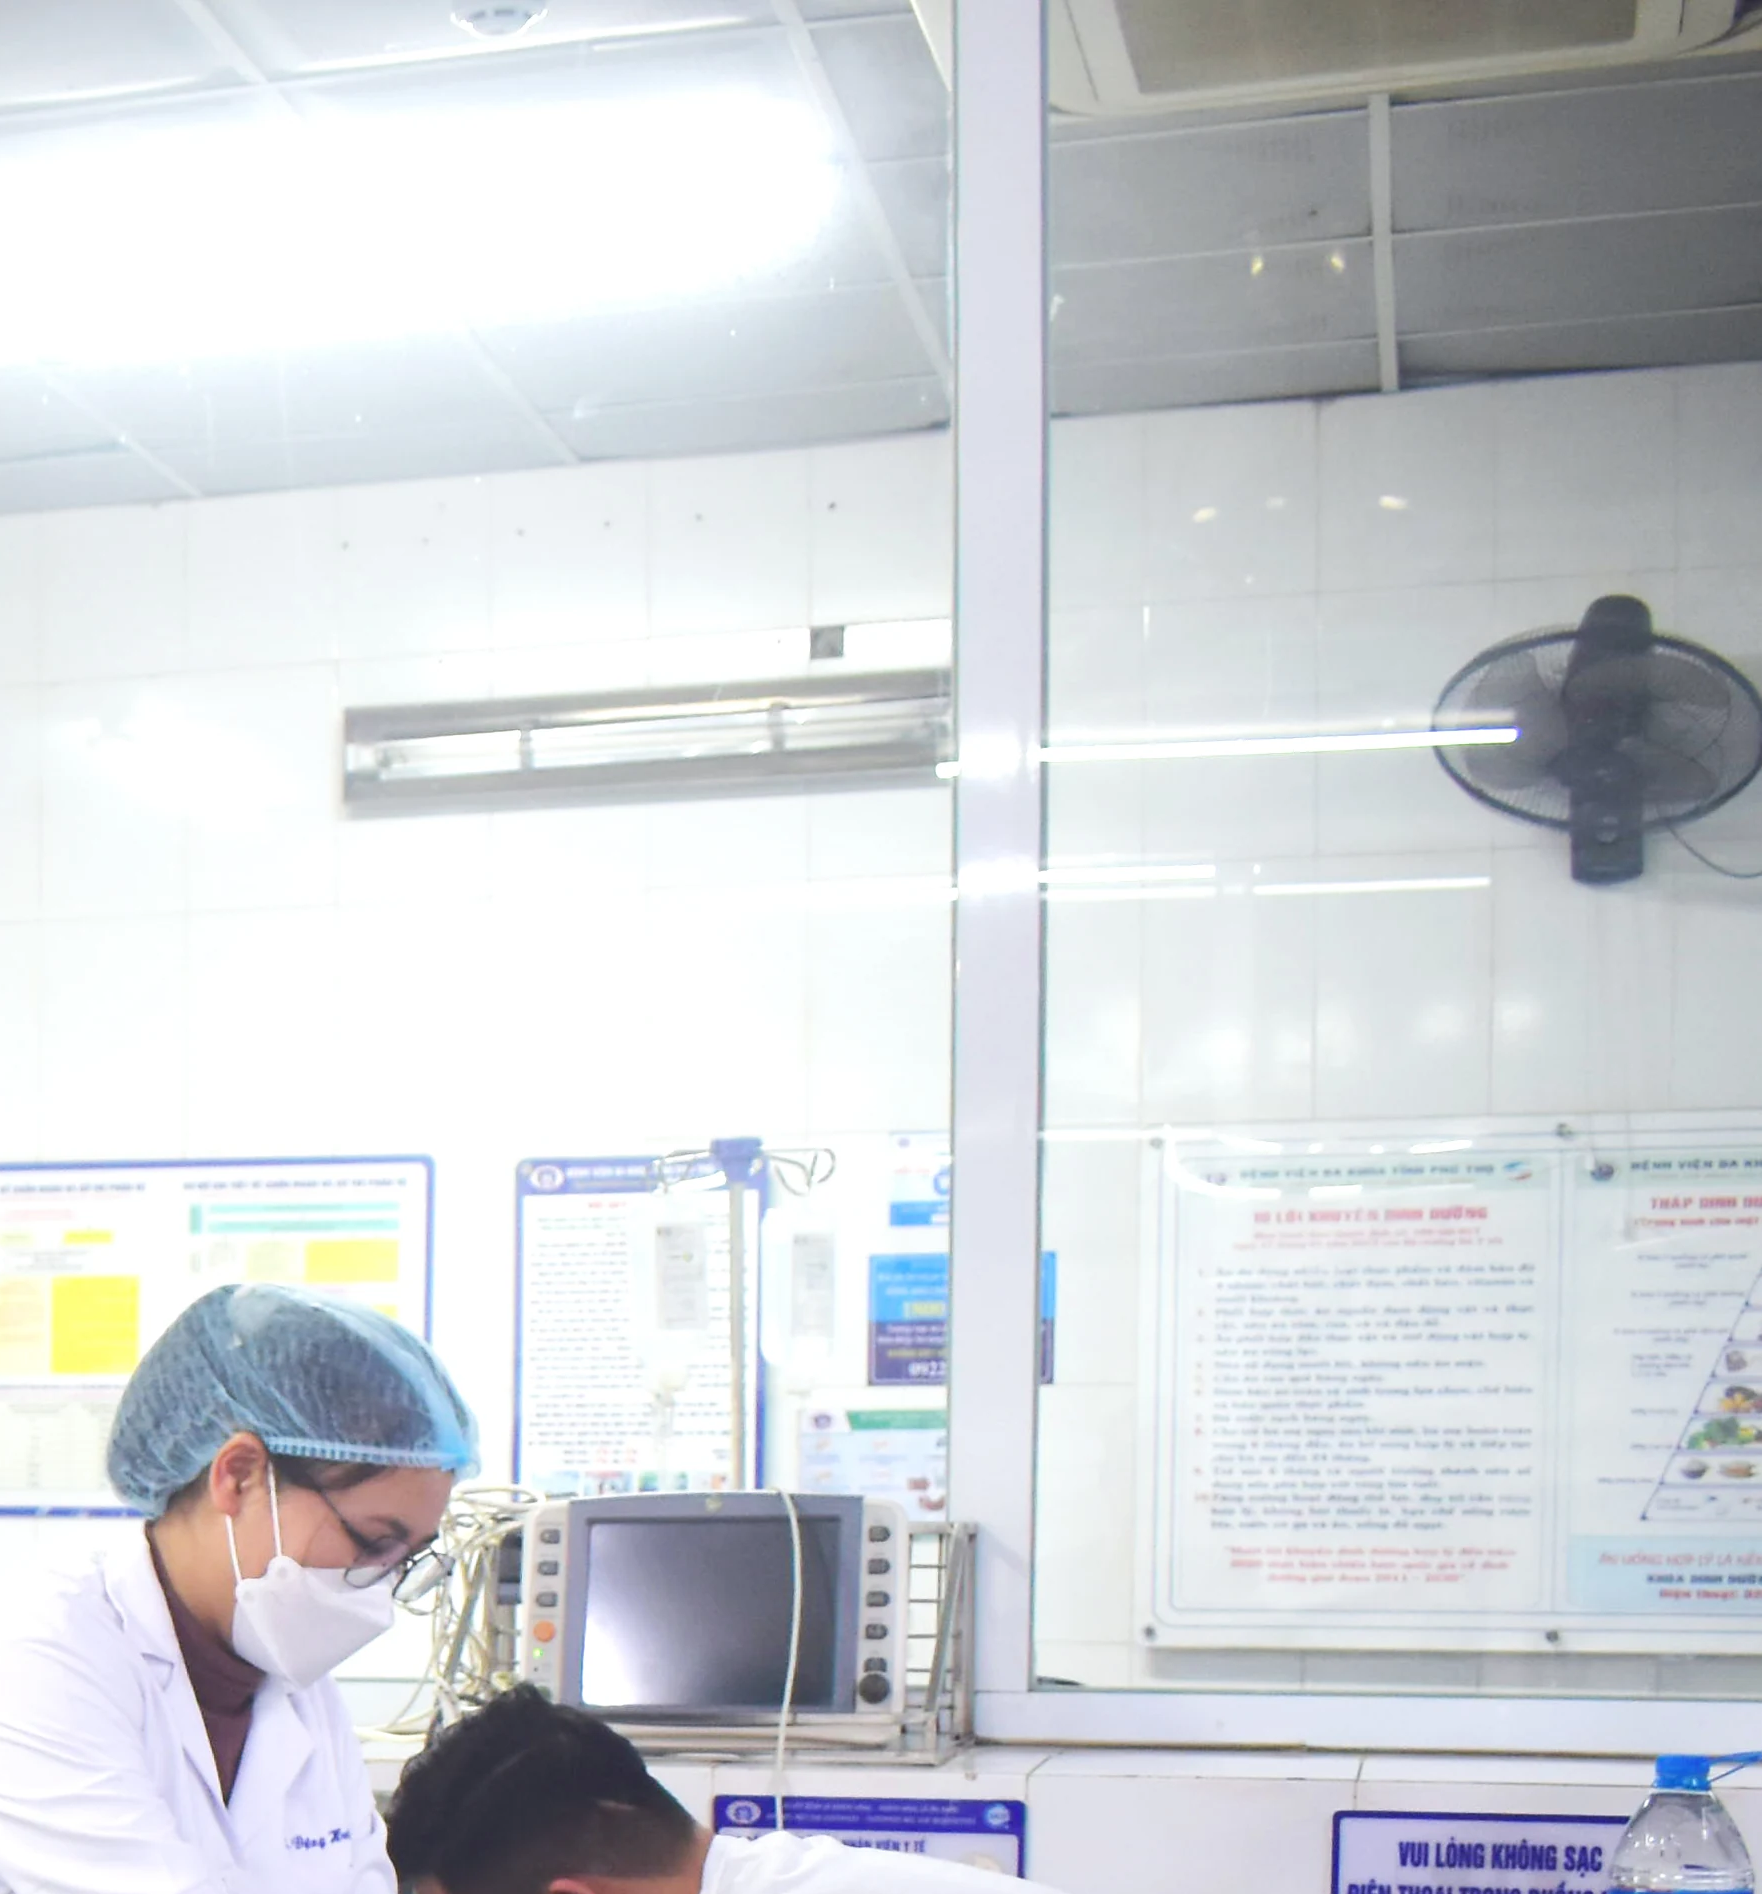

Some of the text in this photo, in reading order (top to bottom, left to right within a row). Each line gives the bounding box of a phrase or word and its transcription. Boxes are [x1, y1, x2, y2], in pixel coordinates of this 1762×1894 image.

[1399, 1836, 1603, 1878] VUI LÒNG KHÔNG SẠC
